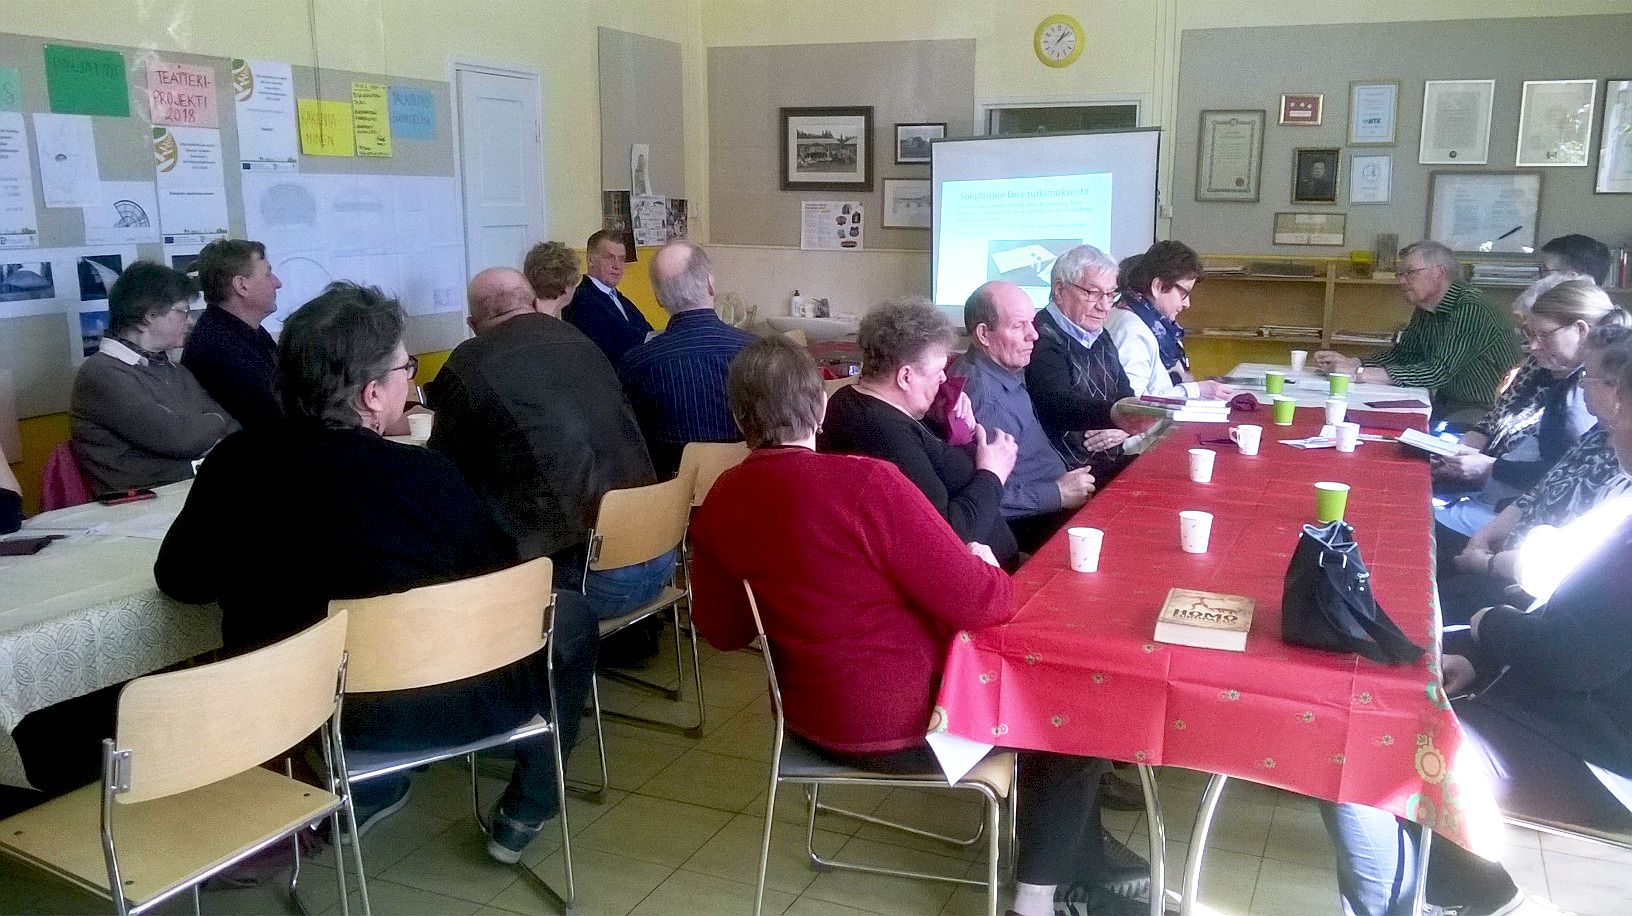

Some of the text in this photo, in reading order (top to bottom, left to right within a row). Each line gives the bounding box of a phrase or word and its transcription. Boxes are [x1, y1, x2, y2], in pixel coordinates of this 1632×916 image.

[154, 70, 211, 88] TEATTERI-
[152, 89, 208, 109] PROJEKTI
[165, 107, 196, 123] 2018
[1007, 187, 1090, 199] Dna-tutkimuksesta
[1172, 608, 1239, 623] HOMO
